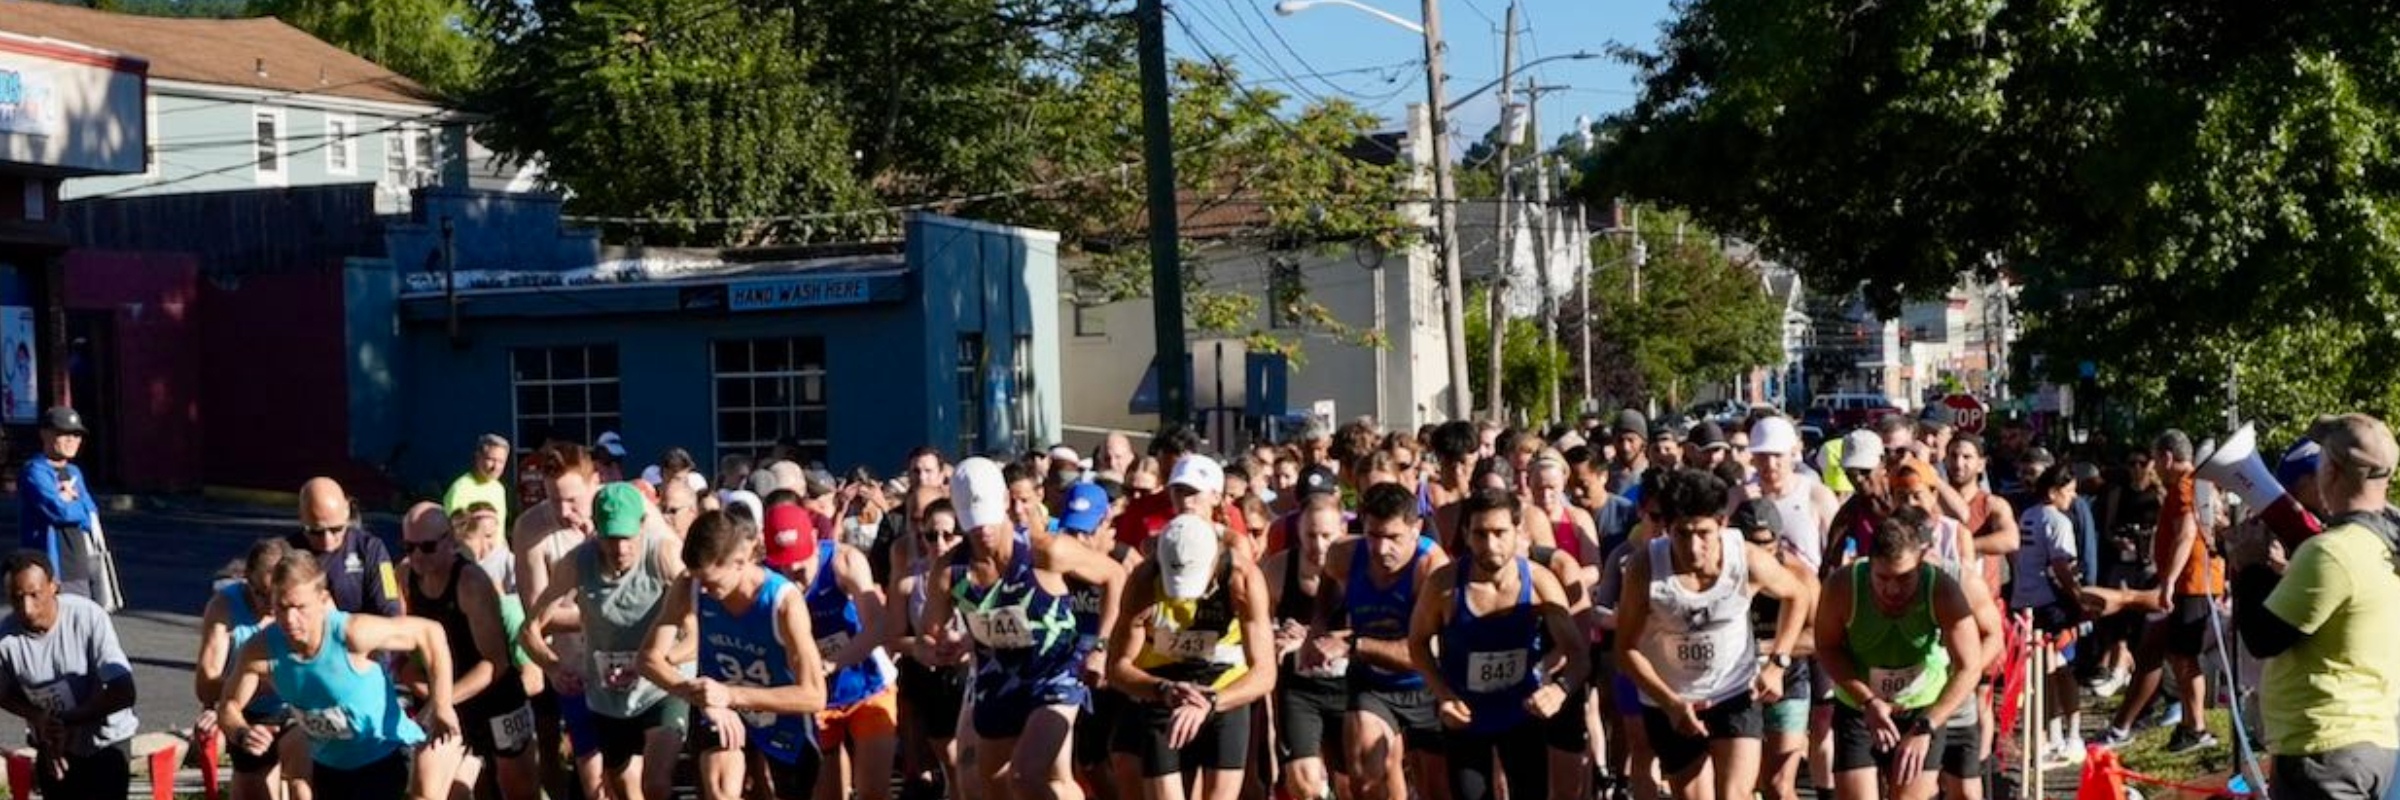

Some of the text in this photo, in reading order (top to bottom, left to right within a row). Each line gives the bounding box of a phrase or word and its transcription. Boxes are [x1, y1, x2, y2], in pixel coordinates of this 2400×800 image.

[779, 284, 822, 302] WASH
[825, 281, 862, 298] HERE
[981, 616, 1018, 638] 744
[1168, 638, 1206, 652] 743
[1678, 643, 1714, 661] 808
[715, 653, 771, 686] 34
[1481, 661, 1516, 681] 843
